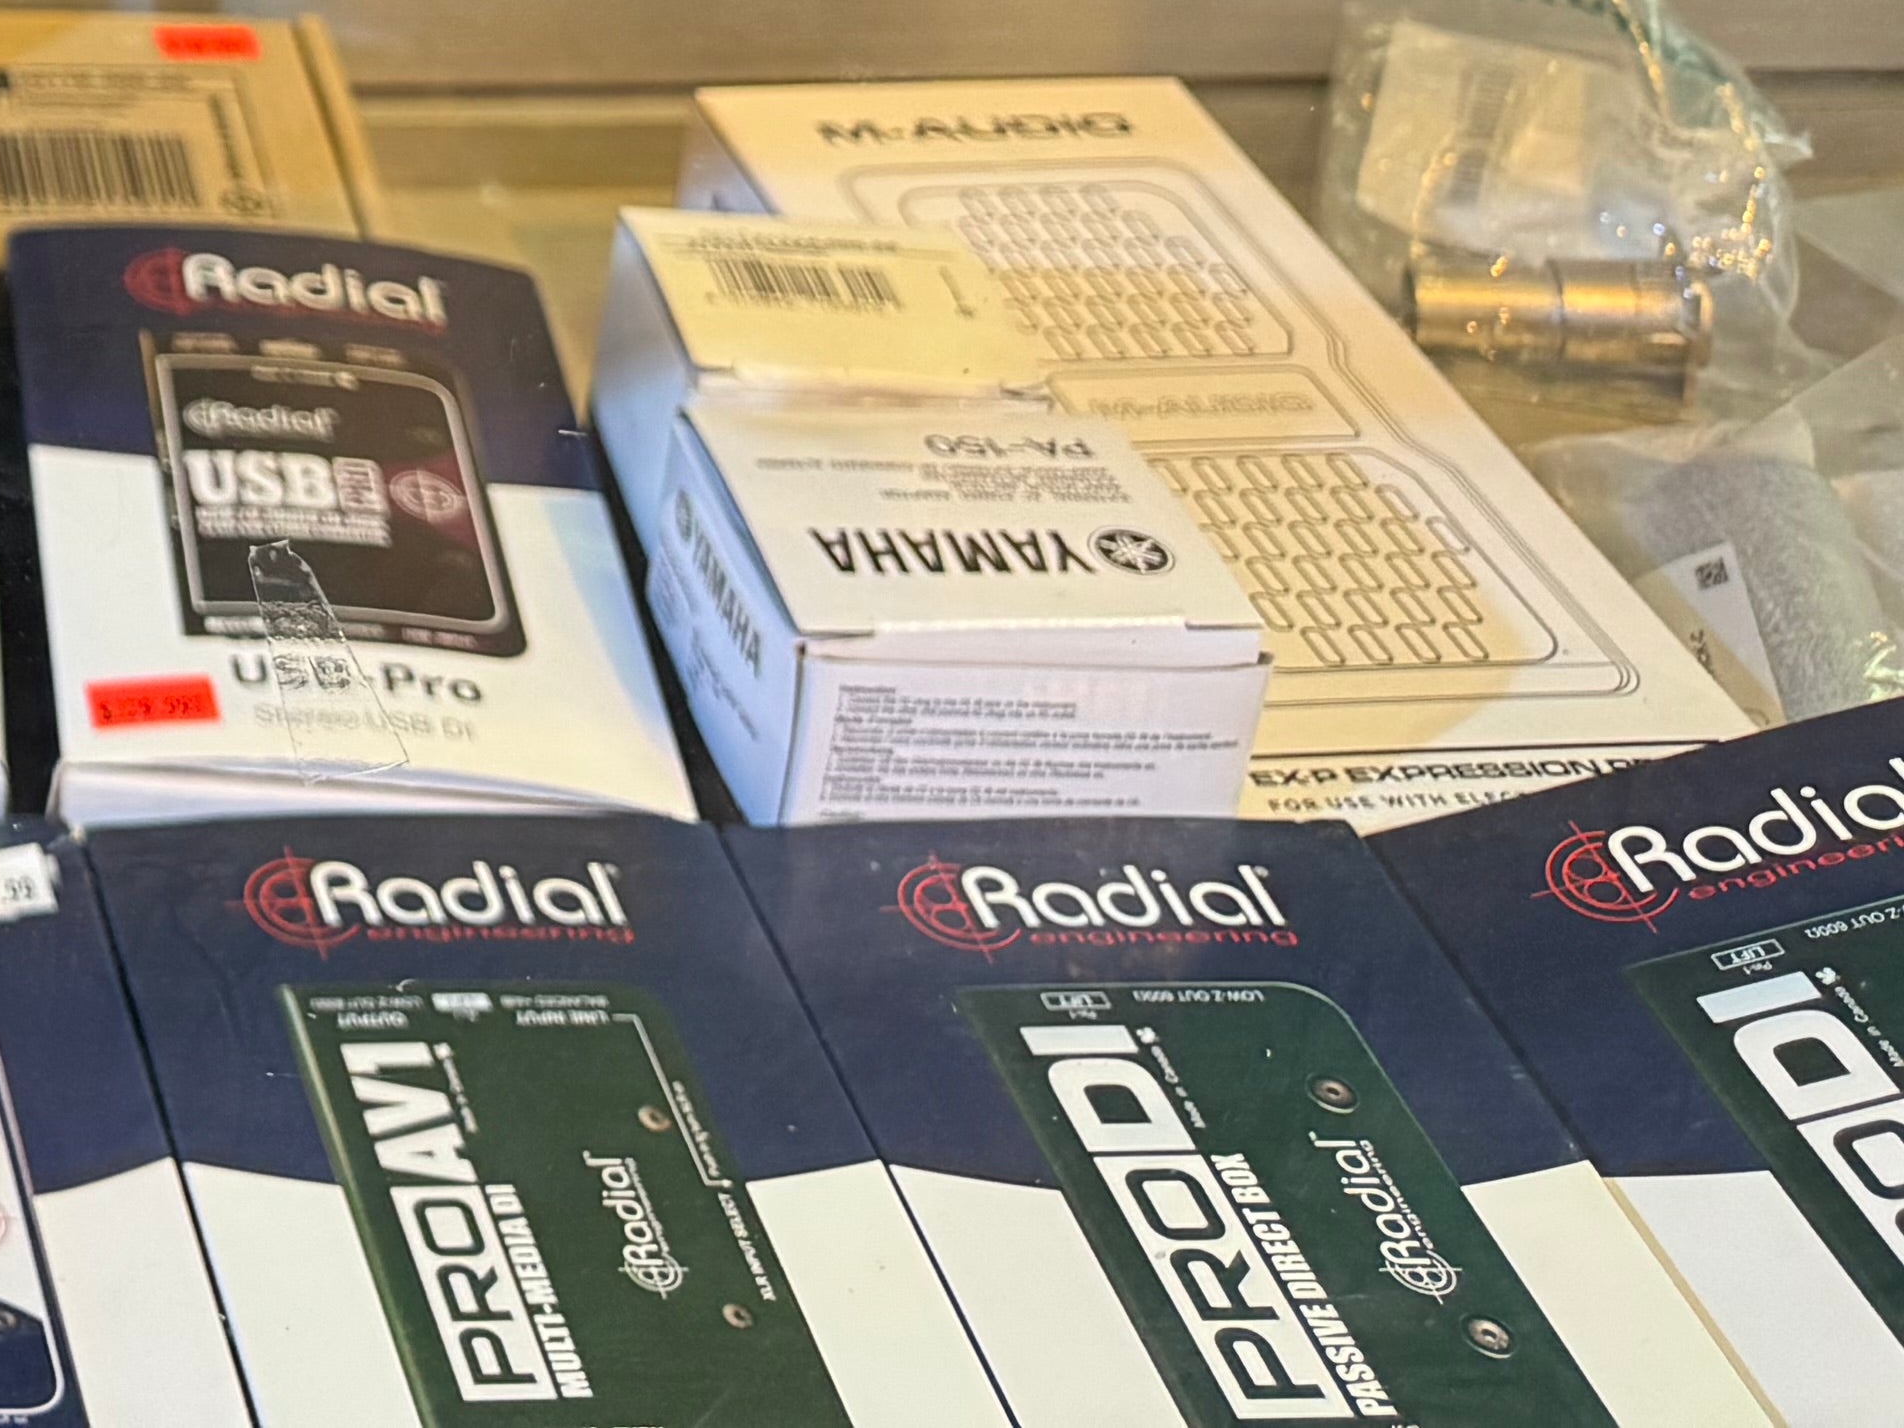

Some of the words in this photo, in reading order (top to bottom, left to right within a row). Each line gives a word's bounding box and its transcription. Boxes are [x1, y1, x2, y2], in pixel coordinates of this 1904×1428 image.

[817, 111, 1138, 146] M-AUDIO
[180, 251, 449, 330] Radial
[924, 432, 1093, 459] PA-150
[183, 449, 340, 511] USB
[808, 524, 1097, 576] YAMAHA
[1268, 796, 1317, 814] FOR
[1326, 795, 1376, 812] USE
[1386, 792, 1448, 809] WITH
[1349, 758, 1602, 786] EXPRESSION
[309, 860, 628, 926] Radial
[960, 865, 1287, 928] Radial
[367, 926, 635, 945] engineering
[1028, 928, 1299, 947] engineering
[1729, 945, 1767, 964] LIFT
[1020, 1025, 1196, 1153] DI
[582, 1149, 662, 1271] Radial
[1210, 1152, 1272, 1206] BOX
[1309, 1130, 1419, 1285] Radial
[1253, 1208, 1320, 1296] DIRECT
[410, 1197, 538, 1386] PRO
[499, 1211, 594, 1398] MULTI-MEDIA
[1126, 1168, 1326, 1400] PRO
[1300, 1297, 1400, 1420] PASSIVE
